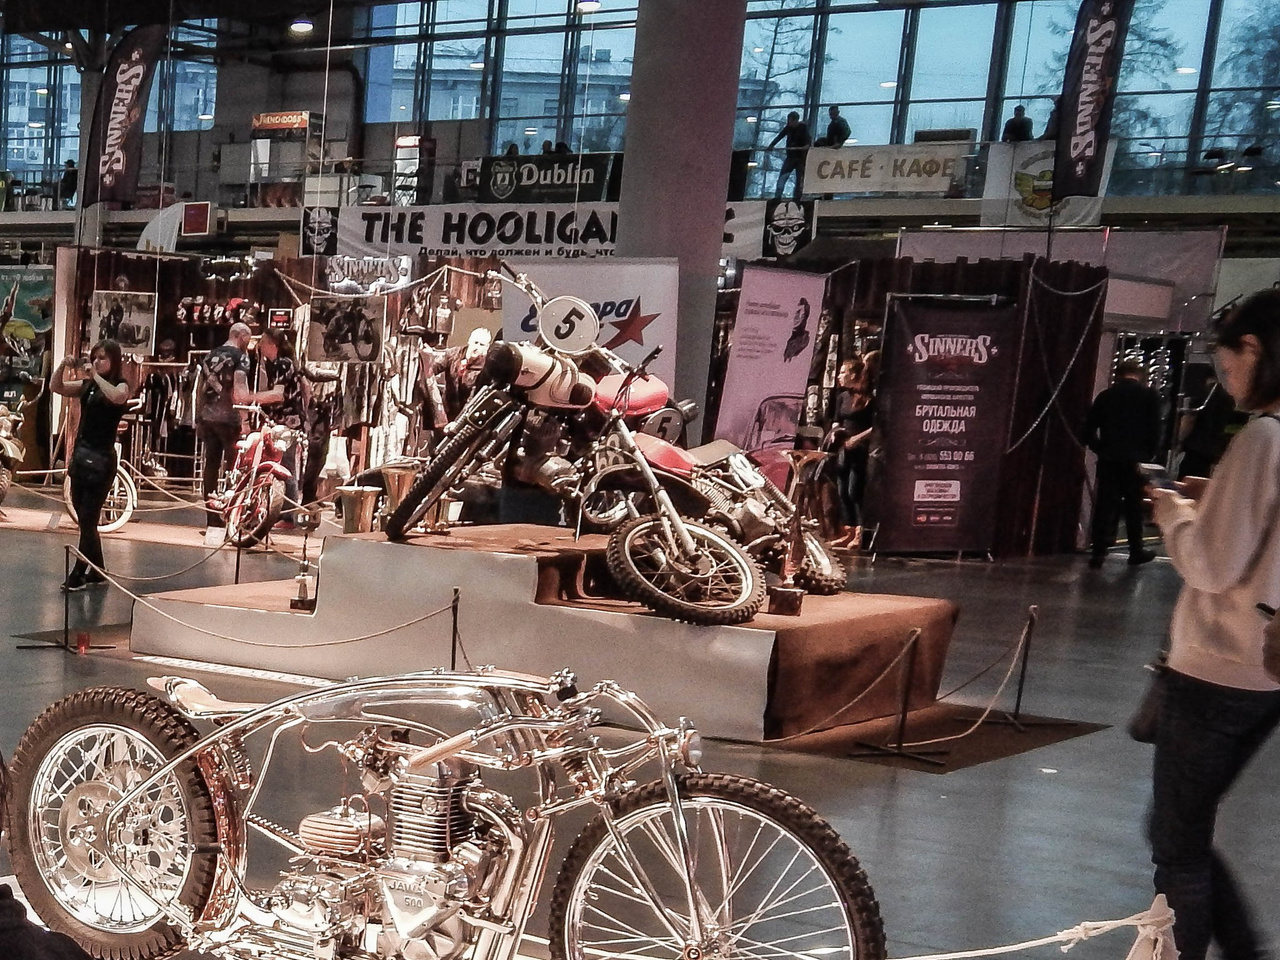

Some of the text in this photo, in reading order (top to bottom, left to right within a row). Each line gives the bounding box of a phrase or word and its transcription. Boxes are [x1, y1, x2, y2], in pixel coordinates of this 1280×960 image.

[1070, 18, 1117, 160] SINNERS
[99, 62, 146, 176] SINNERS
[520, 162, 595, 186] Dublin
[816, 153, 956, 180] CAFÉ КАФЕ
[361, 211, 426, 244] THE
[465, 248, 487, 257] что
[490, 247, 540, 258] должен
[554, 306, 586, 340] 5
[914, 333, 992, 363] SINNERS
[915, 404, 977, 418] БРУТАЛЬНАЯ
[657, 416, 673, 441] 5
[922, 419, 966, 434] ОДЕЖДА
[404, 896, 424, 908] 500
